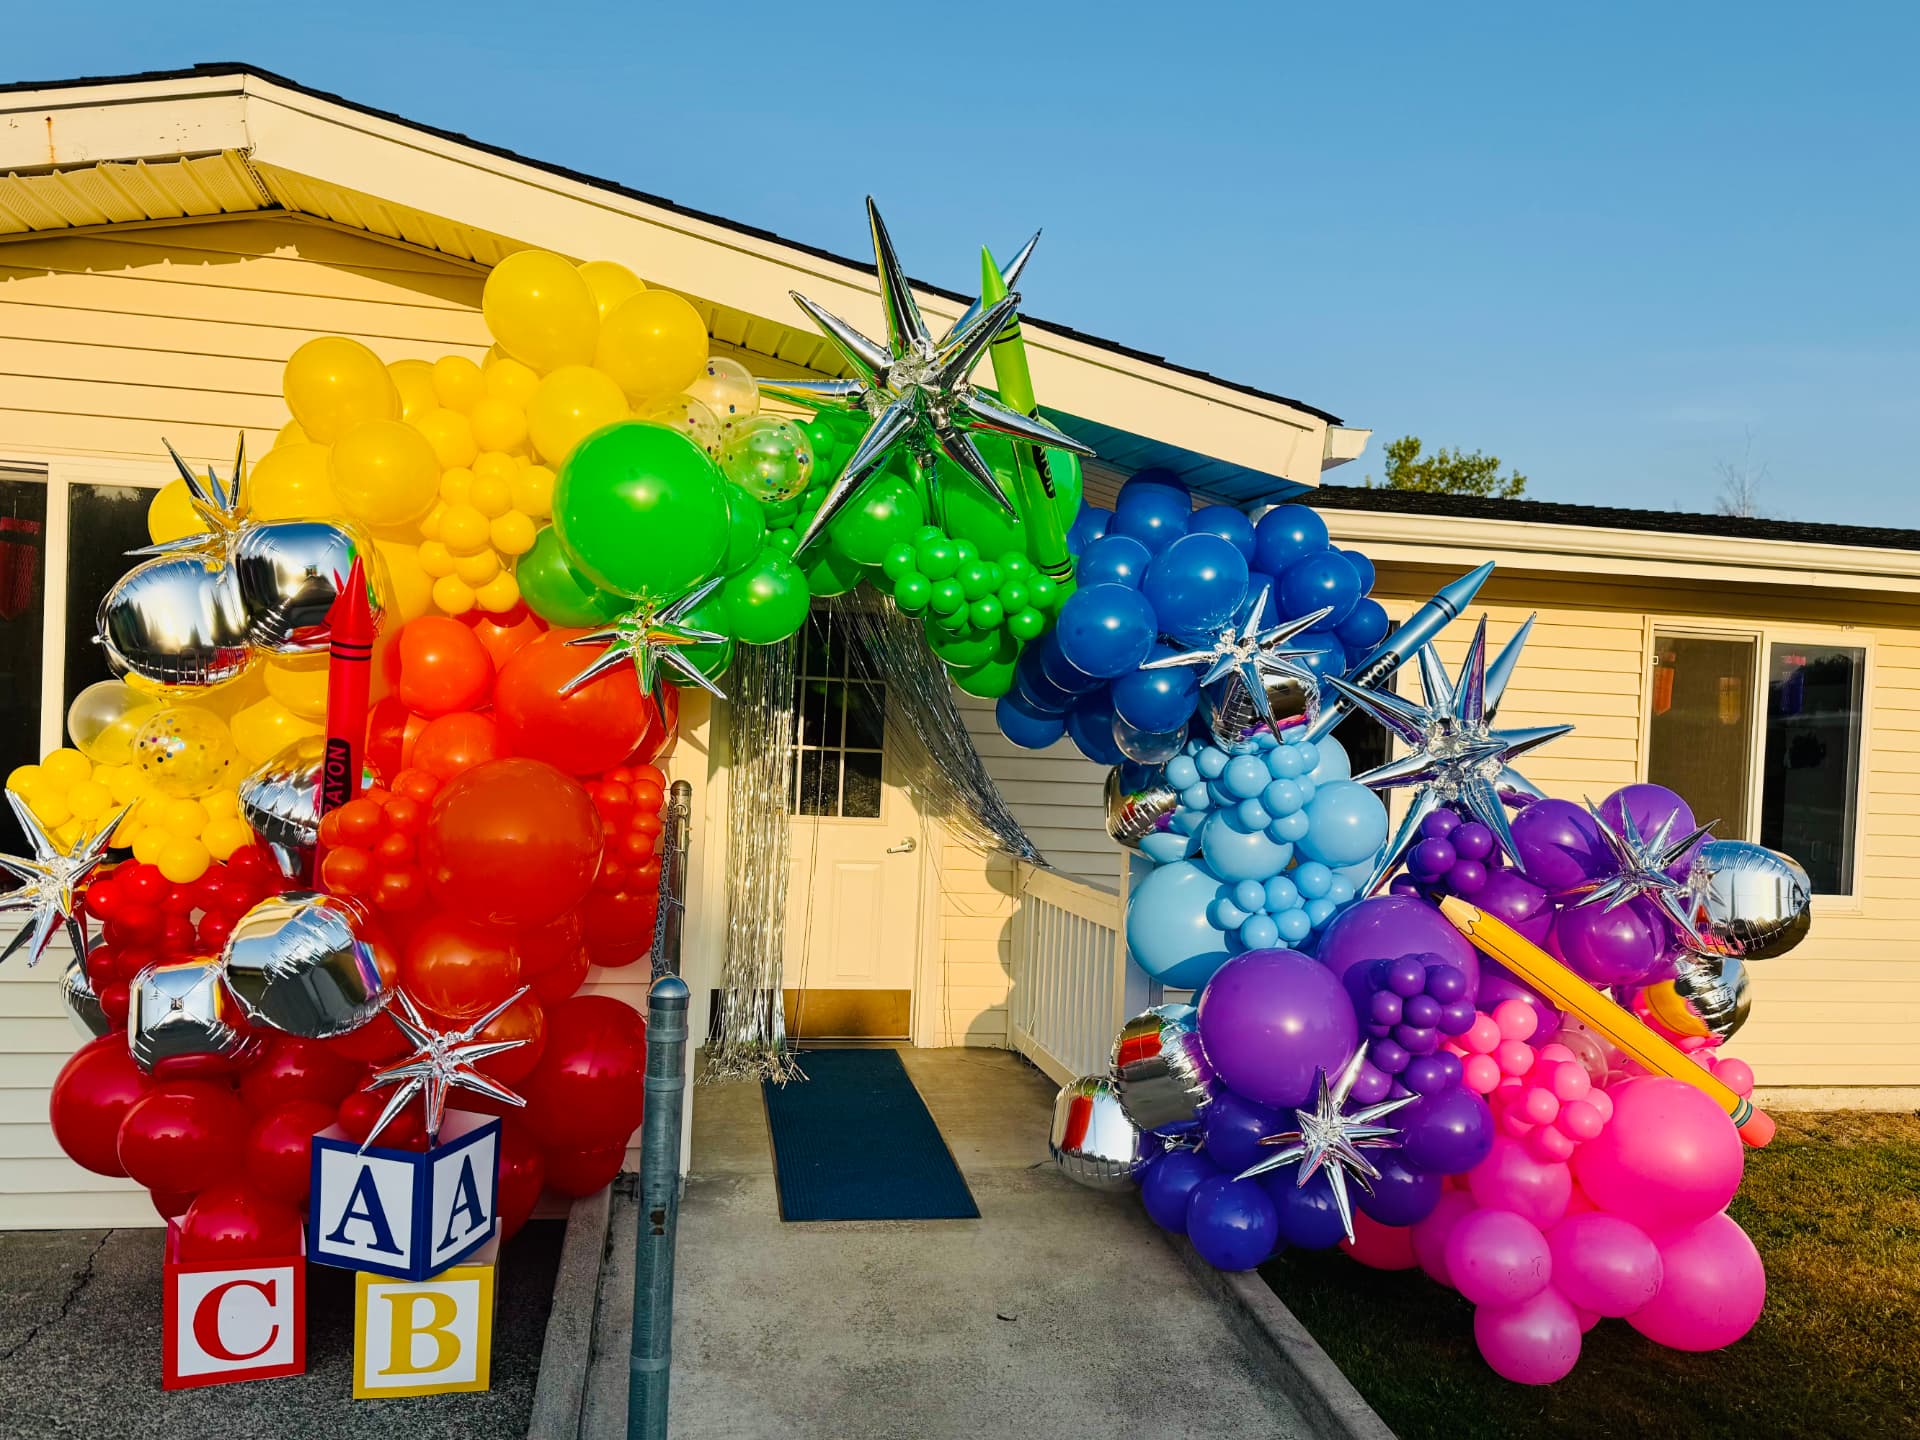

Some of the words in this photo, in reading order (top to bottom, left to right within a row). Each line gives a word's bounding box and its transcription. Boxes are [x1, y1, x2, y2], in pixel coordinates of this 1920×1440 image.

[326, 1164, 404, 1256] A
[437, 1153, 487, 1253] A
[193, 1279, 280, 1361] C
[377, 1291, 461, 1375] B
